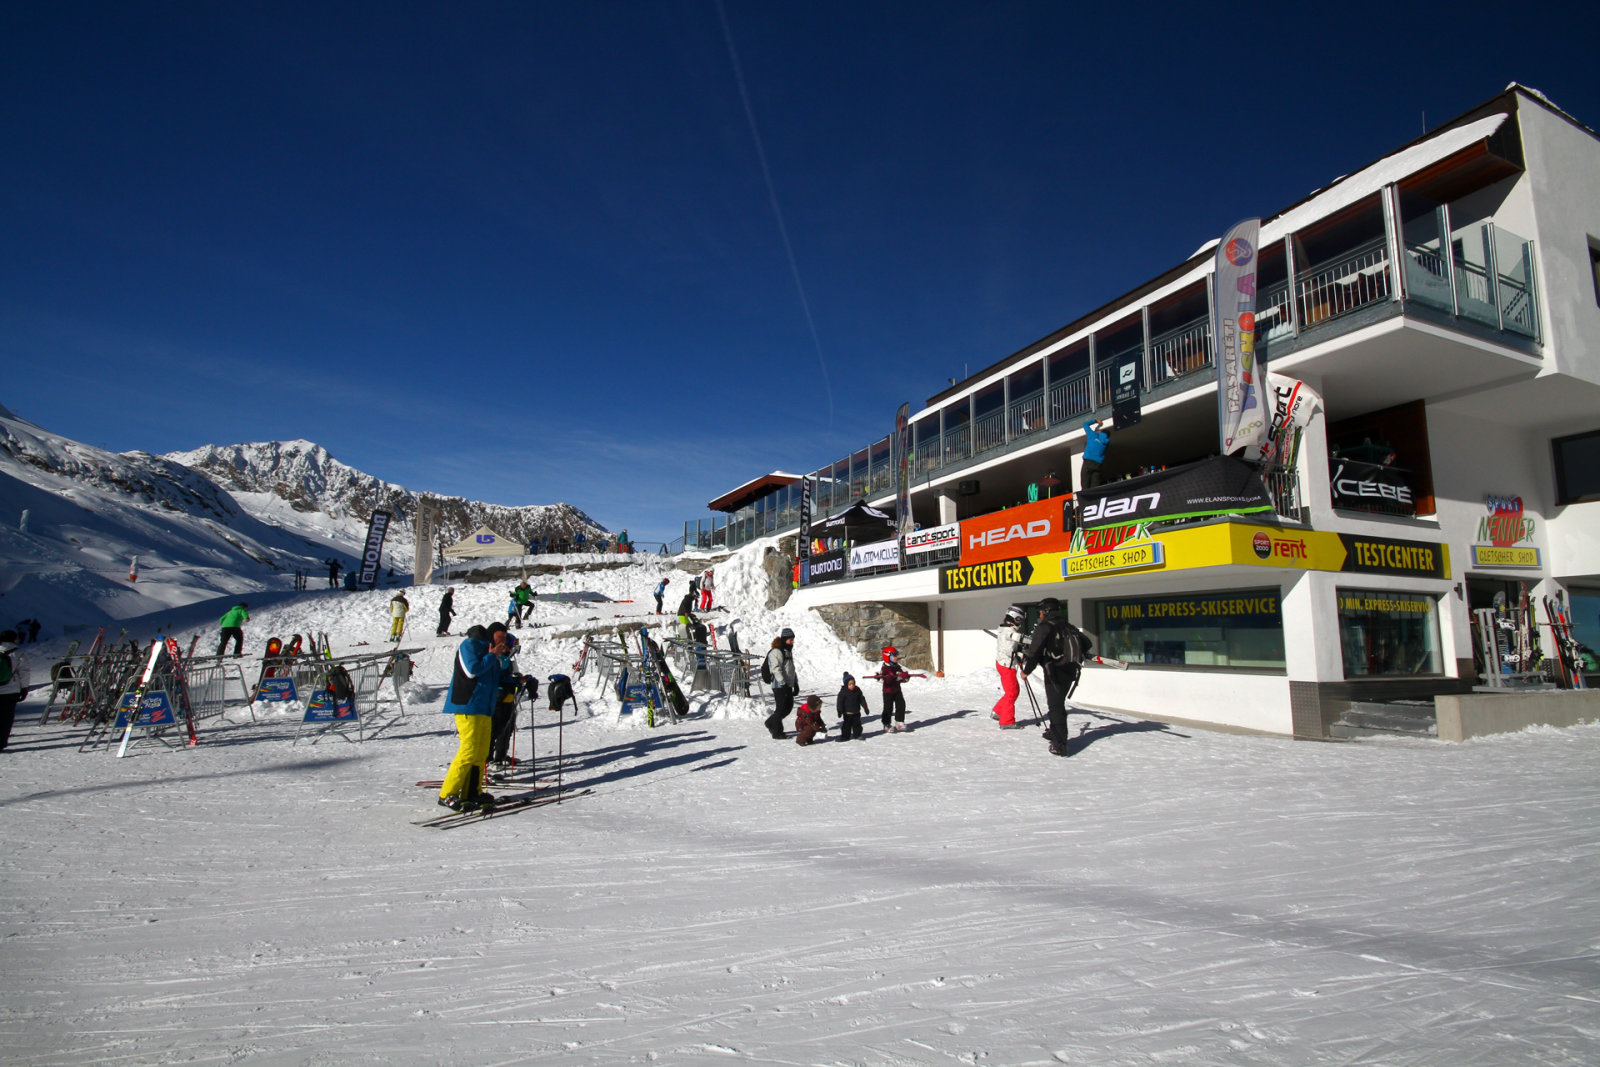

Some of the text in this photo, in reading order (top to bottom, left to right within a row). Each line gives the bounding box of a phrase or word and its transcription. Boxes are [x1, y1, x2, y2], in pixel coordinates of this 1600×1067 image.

[1223, 318, 1240, 413] PASARÉTI
[800, 479, 810, 548] BURTON
[1083, 492, 1160, 522] elan
[363, 513, 388, 572] BURTON
[969, 519, 1050, 550] HEAD
[1069, 521, 1154, 554] NENNER
[1478, 515, 1536, 542] NENNER
[1070, 549, 1147, 572] GLETSCHER SHOP
[1274, 538, 1307, 559] rent
[1355, 542, 1434, 571] TESTCENTER
[1479, 550, 1534, 563] GLETSCHER SHOP
[811, 560, 837, 576] BURTON
[946, 560, 1022, 590] TESTCENTER
[1106, 598, 1276, 619] 10 MIN. EXPRESS-SKISERVICE
[1345, 597, 1363, 610] MIN.
